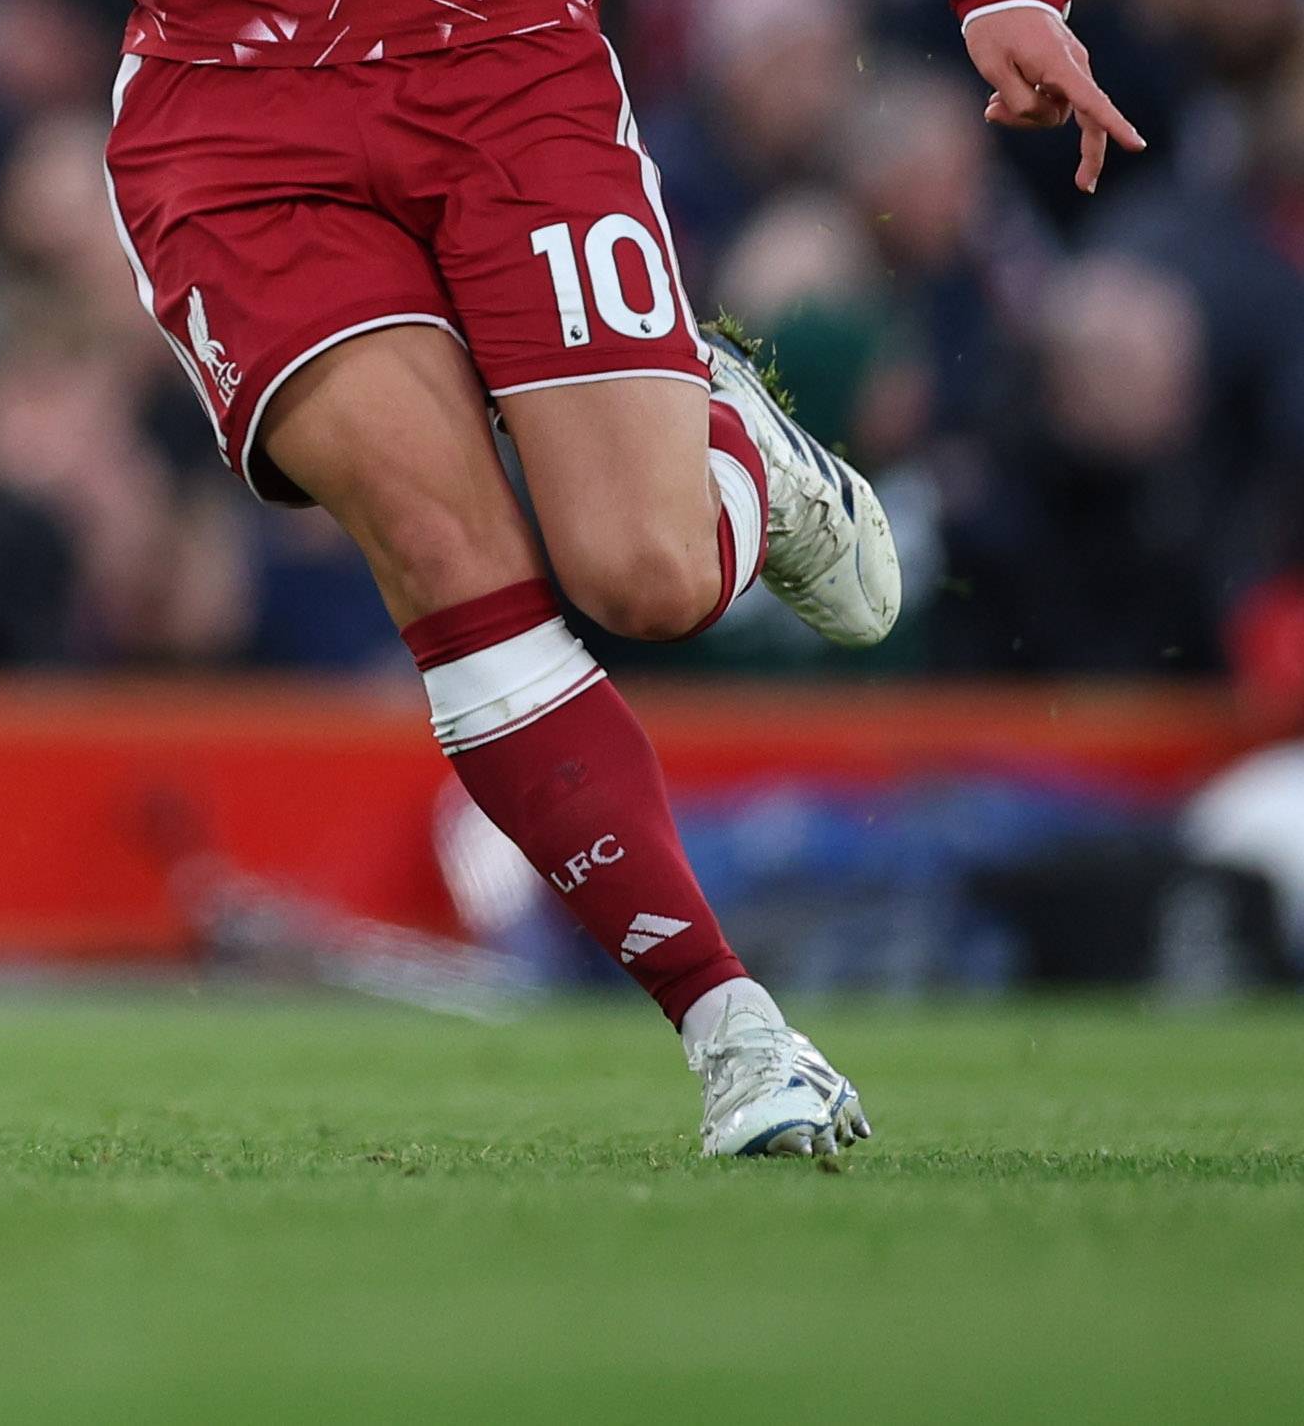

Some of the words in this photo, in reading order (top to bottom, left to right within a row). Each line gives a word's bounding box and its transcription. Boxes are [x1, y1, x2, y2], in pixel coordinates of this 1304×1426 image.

[530, 213, 677, 347] 10
[218, 362, 242, 409] LFC
[550, 834, 626, 894] LFC
